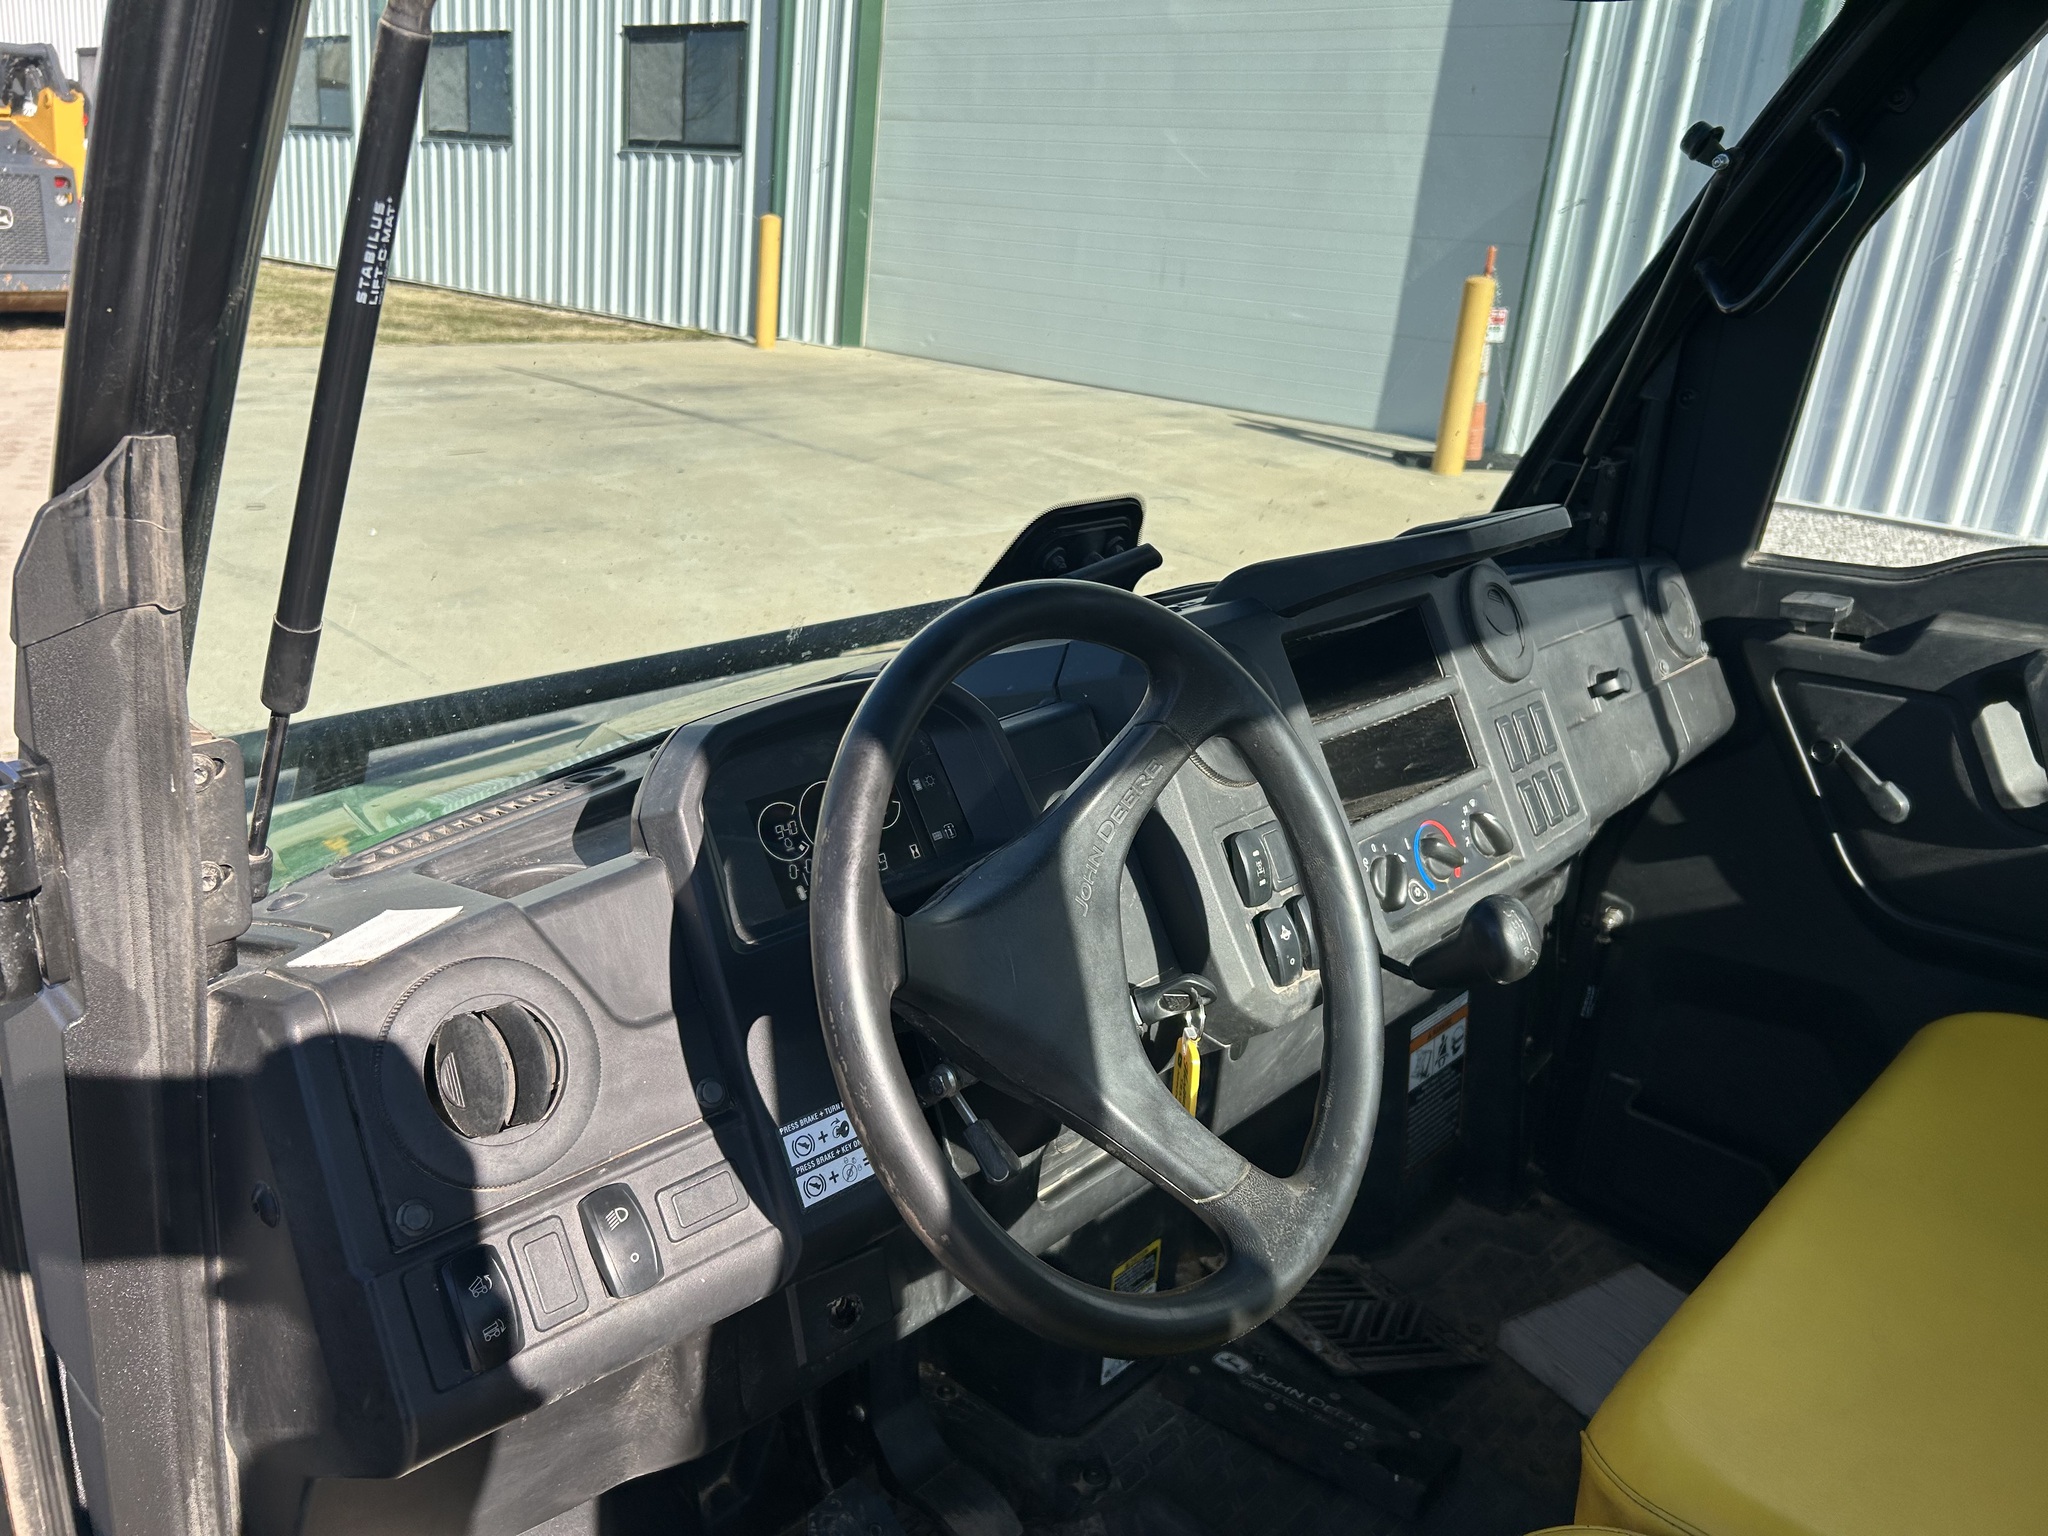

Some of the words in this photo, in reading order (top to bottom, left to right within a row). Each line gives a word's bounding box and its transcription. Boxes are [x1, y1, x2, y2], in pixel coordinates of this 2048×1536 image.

[355, 200, 386, 305] STABILUS
[1075, 845, 1105, 918] JOHN
[1096, 758, 1164, 845] DEERE
[779, 1121, 800, 1136] PRESS
[799, 1113, 819, 1130] BRAKE
[824, 1103, 841, 1115] TURN
[795, 1160, 816, 1175] PRESS
[815, 1152, 836, 1167] BRAKE
[841, 1143, 852, 1154] KEY
[1250, 1372, 1306, 1400] JOHN
